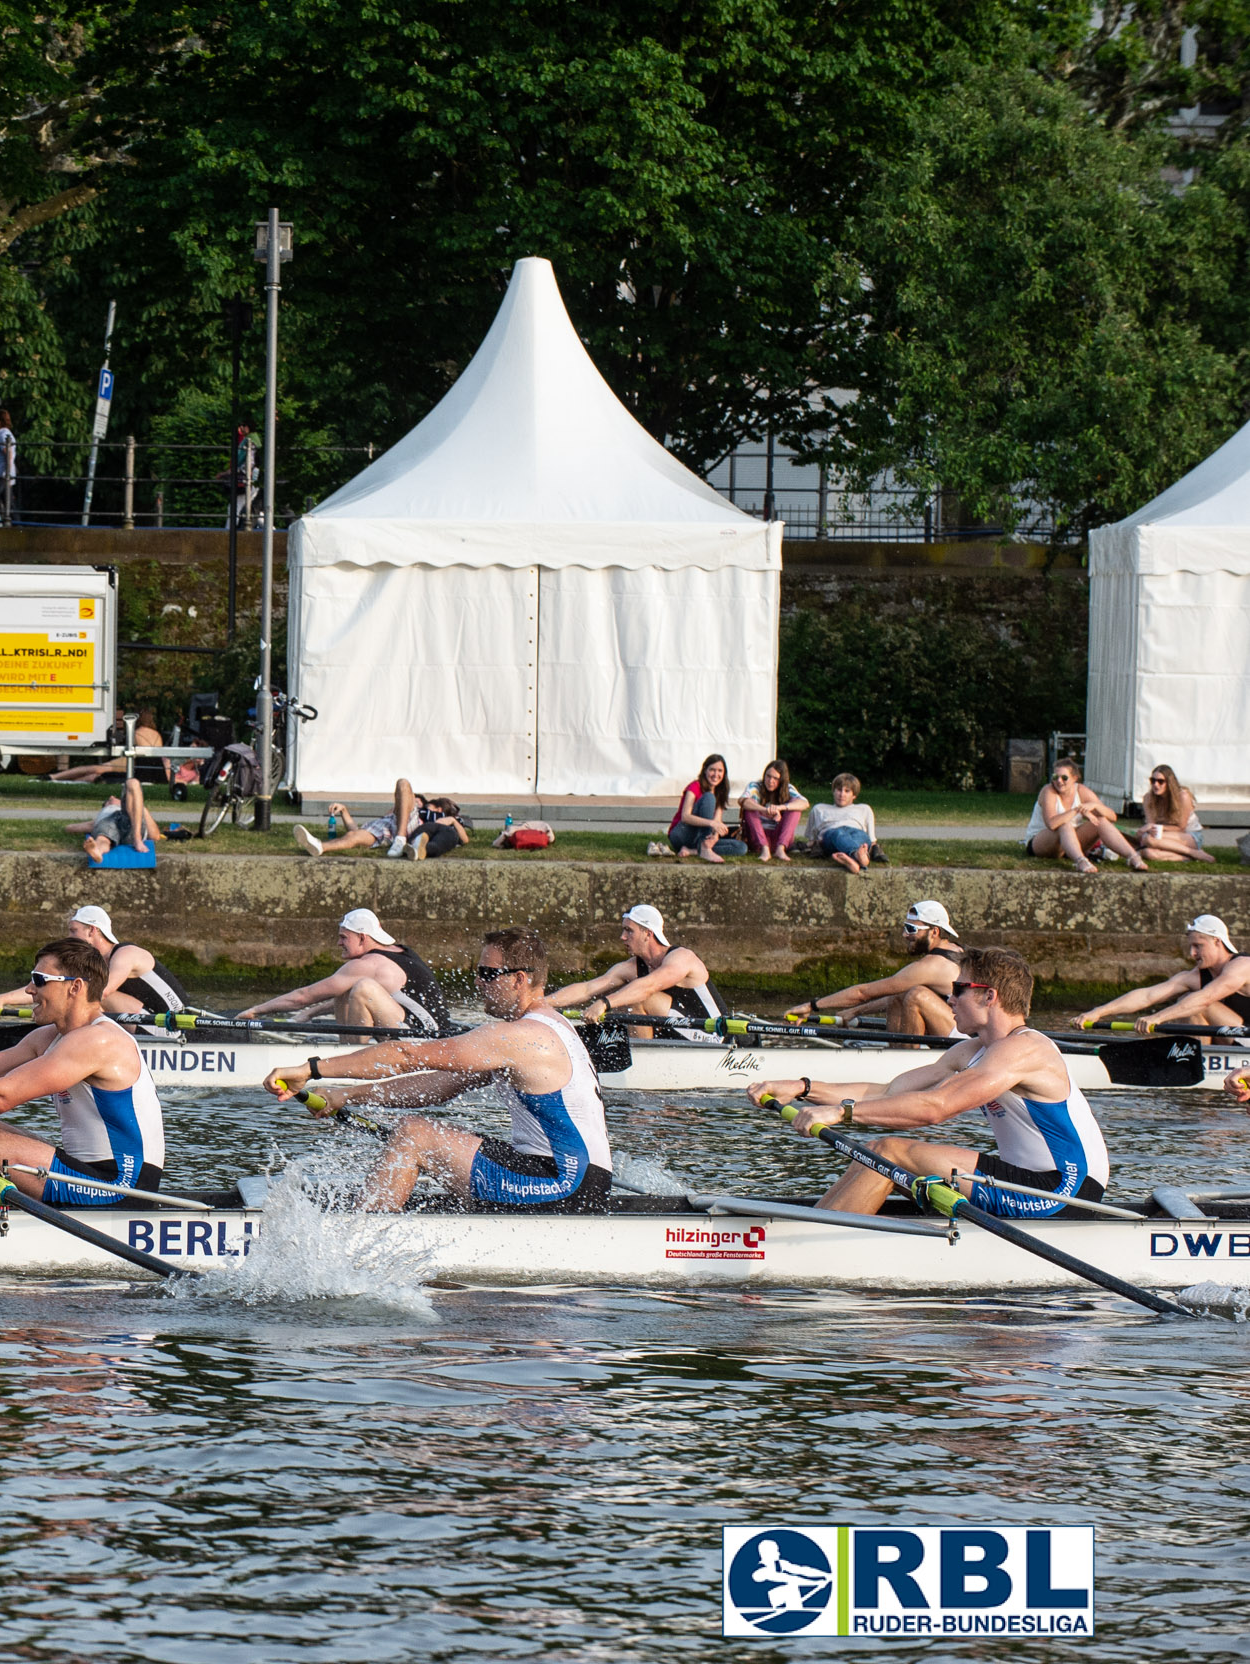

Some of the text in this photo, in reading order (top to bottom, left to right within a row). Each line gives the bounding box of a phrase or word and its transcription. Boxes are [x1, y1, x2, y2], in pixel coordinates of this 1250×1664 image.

[101, 372, 111, 396] P
[31, 661, 83, 670] ZUKUNFT
[28, 673, 47, 681] MIT
[50, 673, 57, 681] E
[128, 1219, 262, 1257] BERLI
[665, 1228, 741, 1248] hilzinger
[1150, 1233, 1250, 1257] DWB
